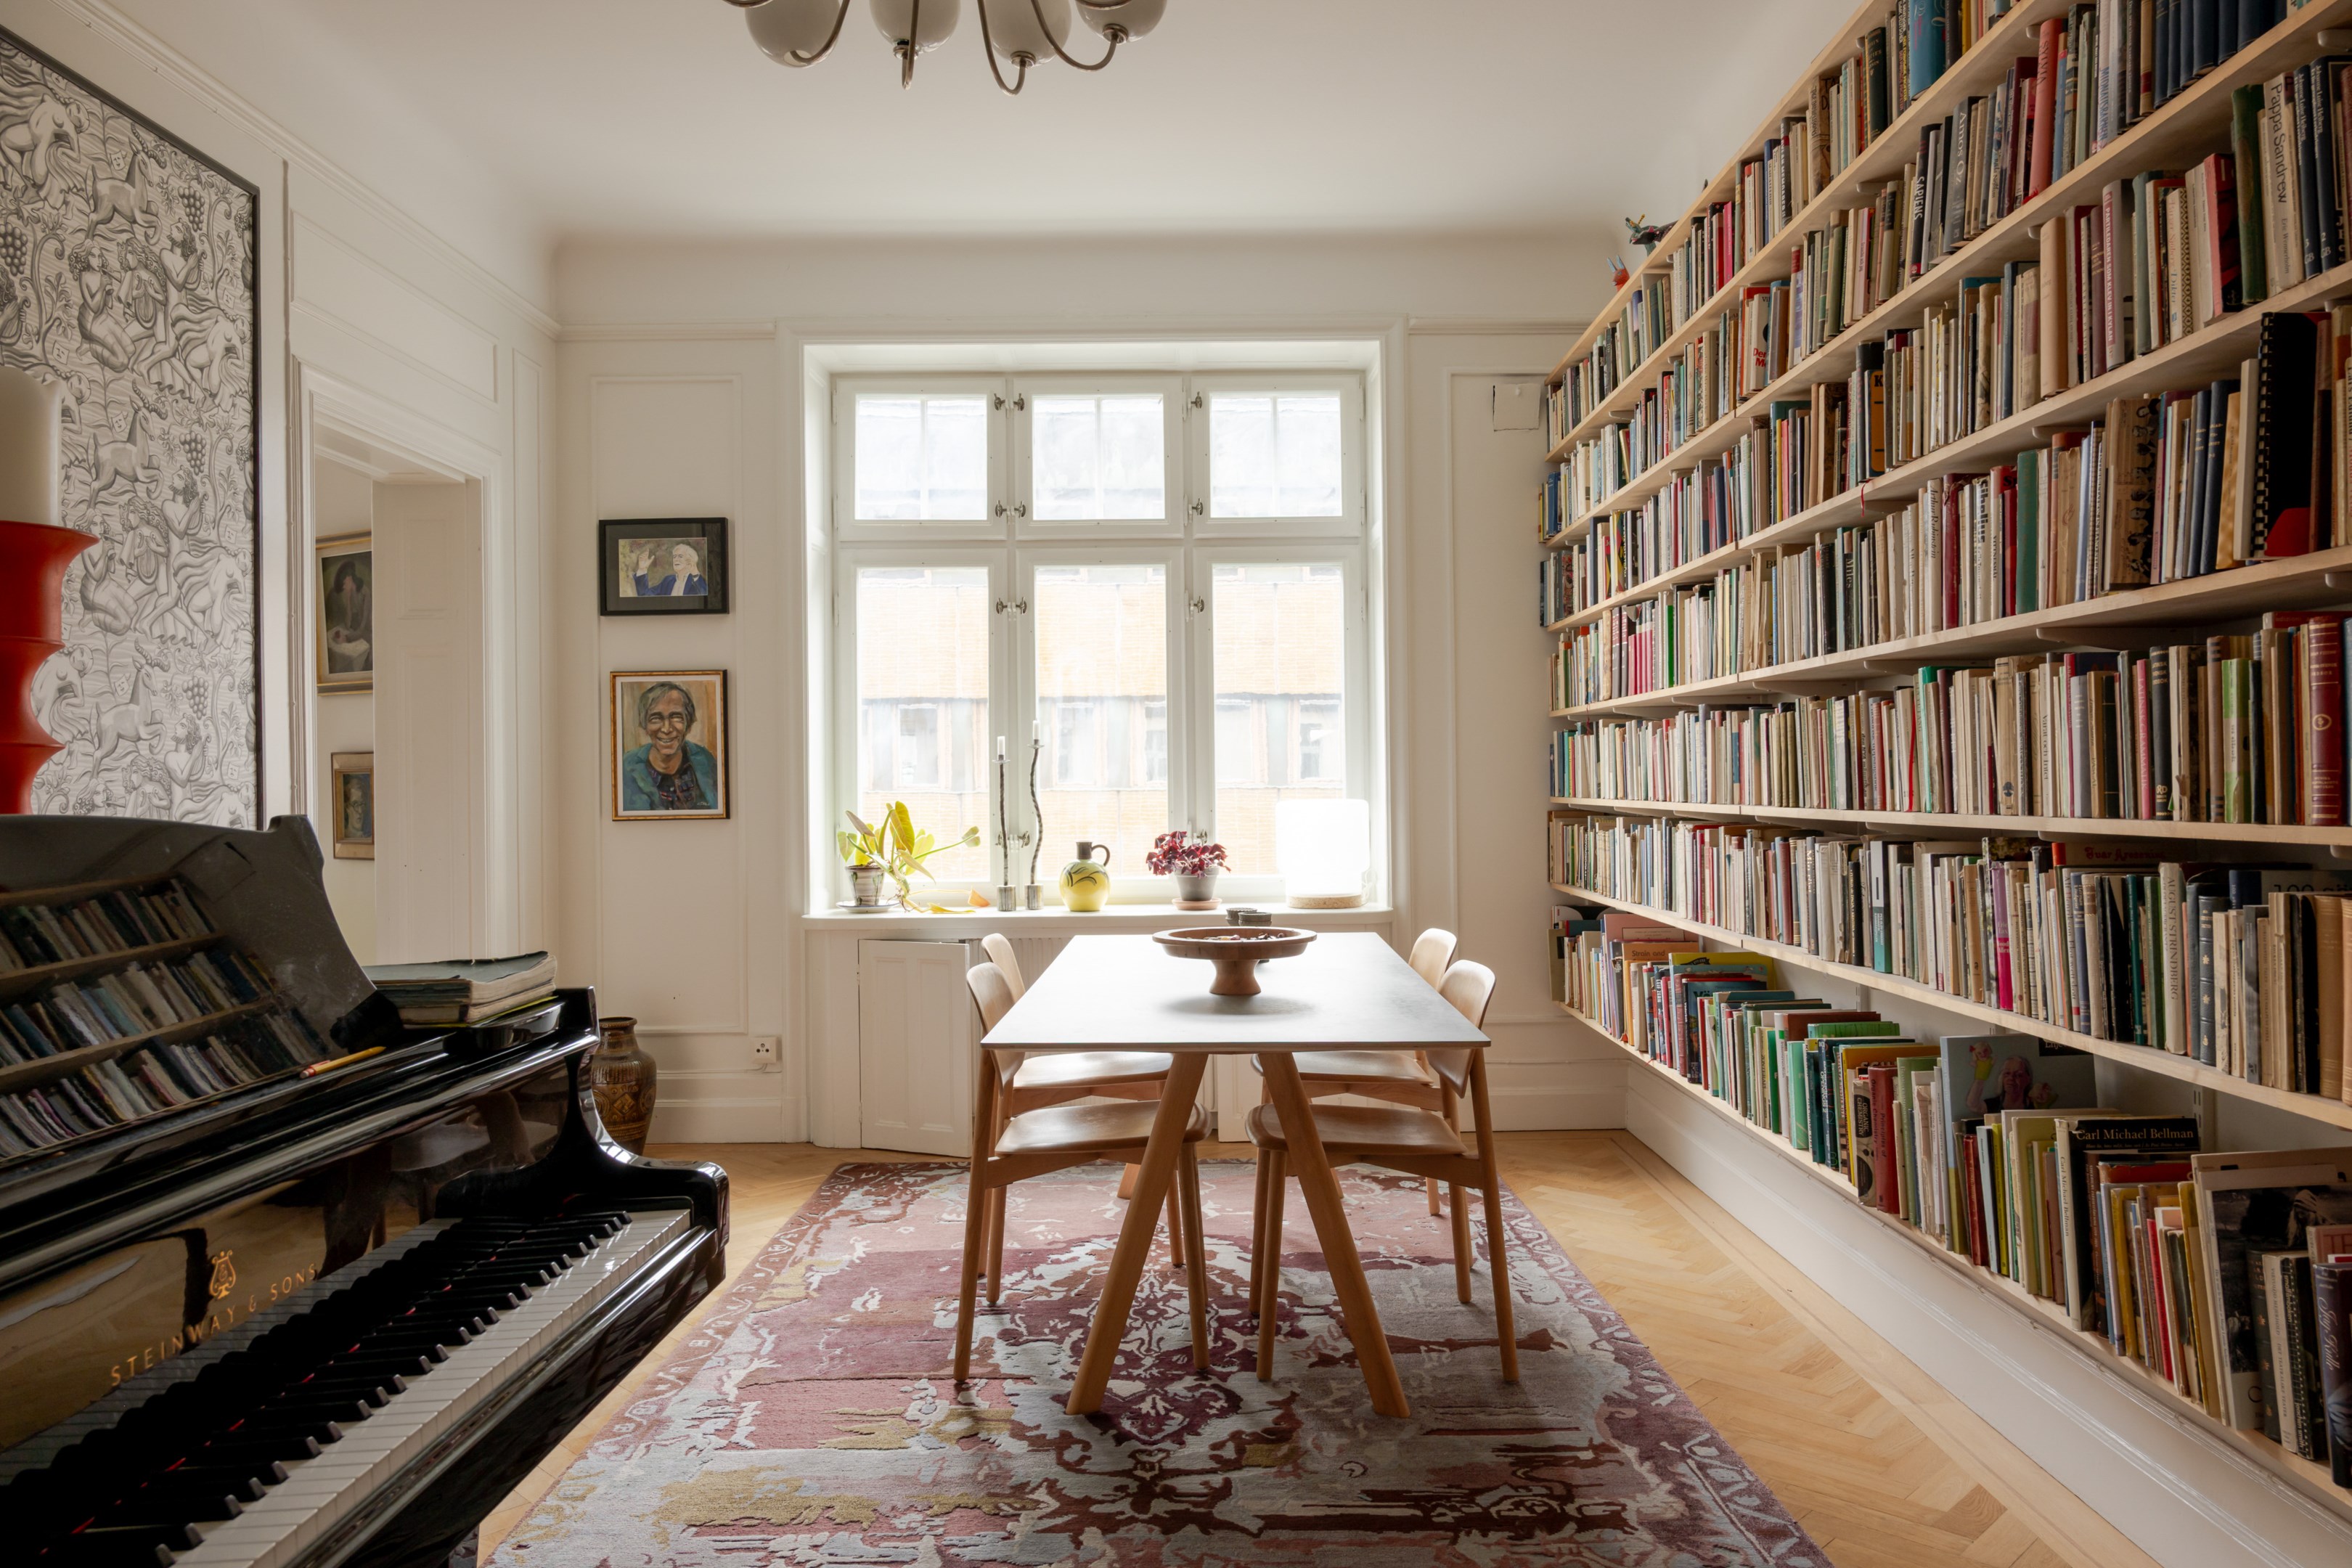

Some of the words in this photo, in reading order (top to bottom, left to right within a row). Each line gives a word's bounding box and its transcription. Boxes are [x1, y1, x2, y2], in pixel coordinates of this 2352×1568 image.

[2268, 83, 2286, 134] Pappa
[1957, 112, 1967, 156] Amos
[1955, 160, 1965, 185] Oz
[2274, 134, 2290, 203] Sandrew
[1914, 176, 1924, 220] SAPIENS
[2282, 232, 2290, 274] Wennerholm
[2107, 302, 2113, 311] IN
[1930, 486, 1939, 514] Arthur
[1652, 950, 1665, 958] and
[2169, 924, 2179, 1000] STRINDBERG
[2076, 1129, 2099, 1140] Carl
[2104, 1128, 2147, 1139] Michael
[2150, 1127, 2194, 1138] Bellman
[2283, 1275, 2293, 1323] smalfilmboken
[110, 1304, 237, 1387] STEINWAY
[248, 1294, 257, 1312] &
[270, 1262, 317, 1302] SONS
[2324, 1334, 2340, 1371] Kulle
